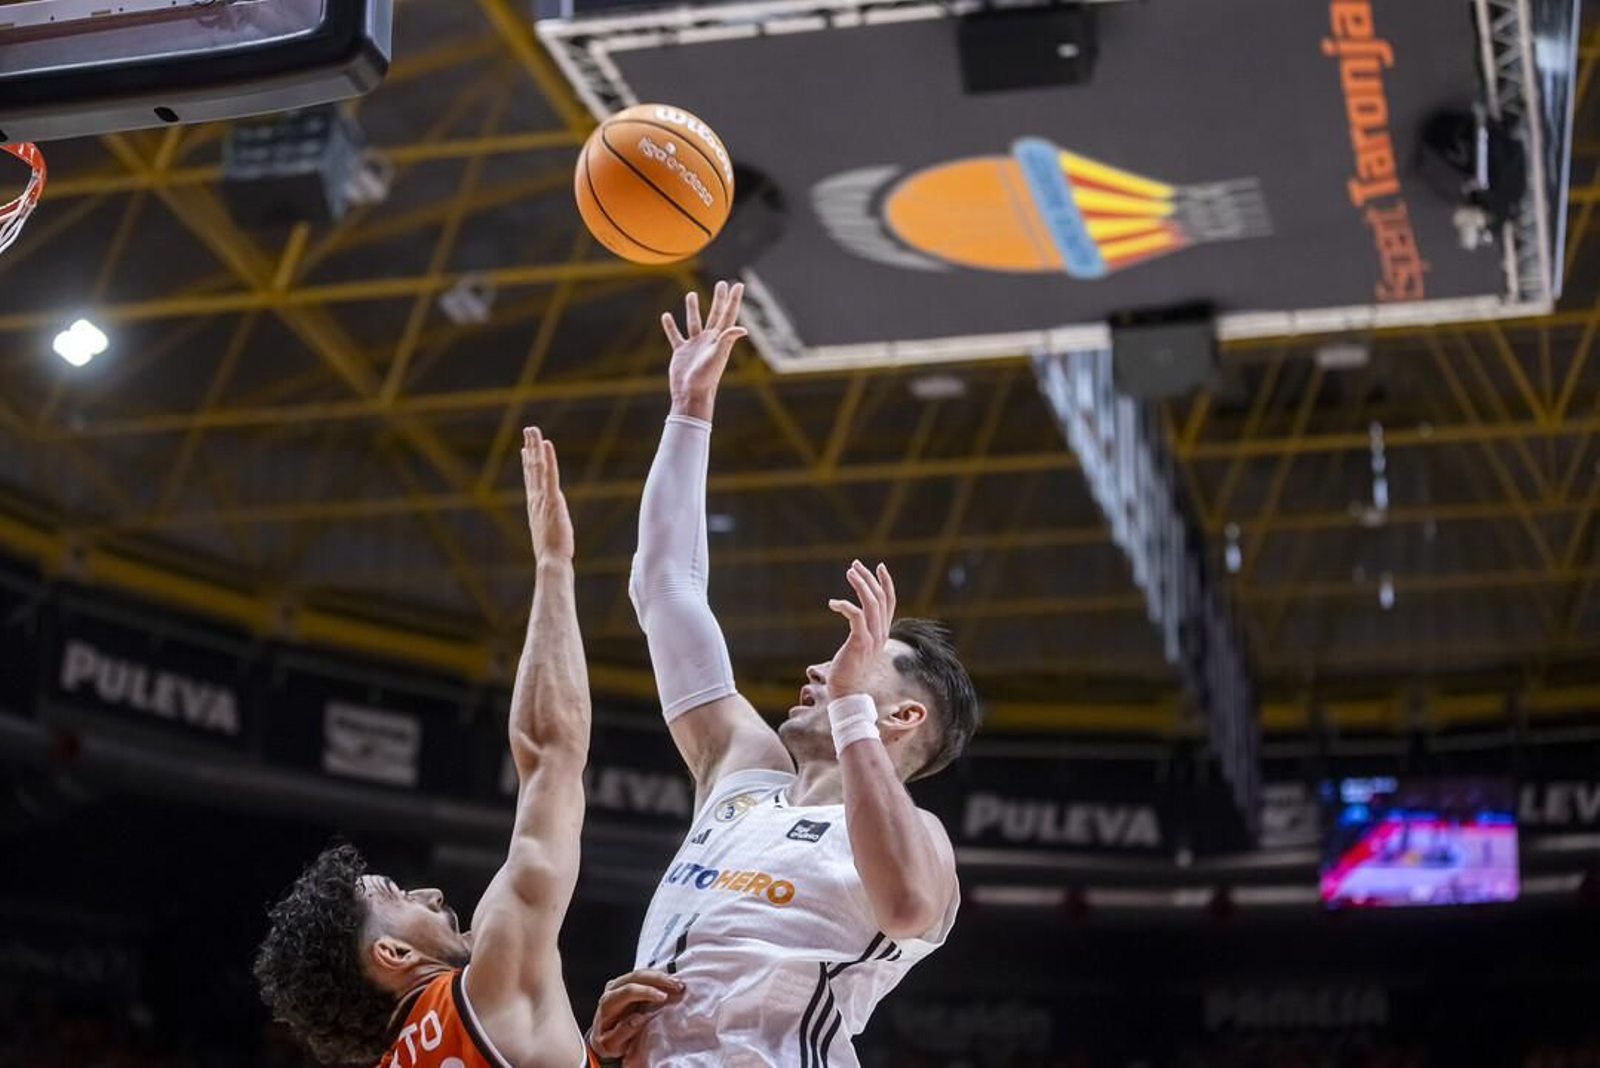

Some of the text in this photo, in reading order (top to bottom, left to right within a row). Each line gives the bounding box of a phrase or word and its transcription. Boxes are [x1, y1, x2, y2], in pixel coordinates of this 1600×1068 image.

[1319, 0, 1399, 206] Taronja
[60, 640, 239, 736] PULEVA
[963, 793, 1162, 847] PULEVA
